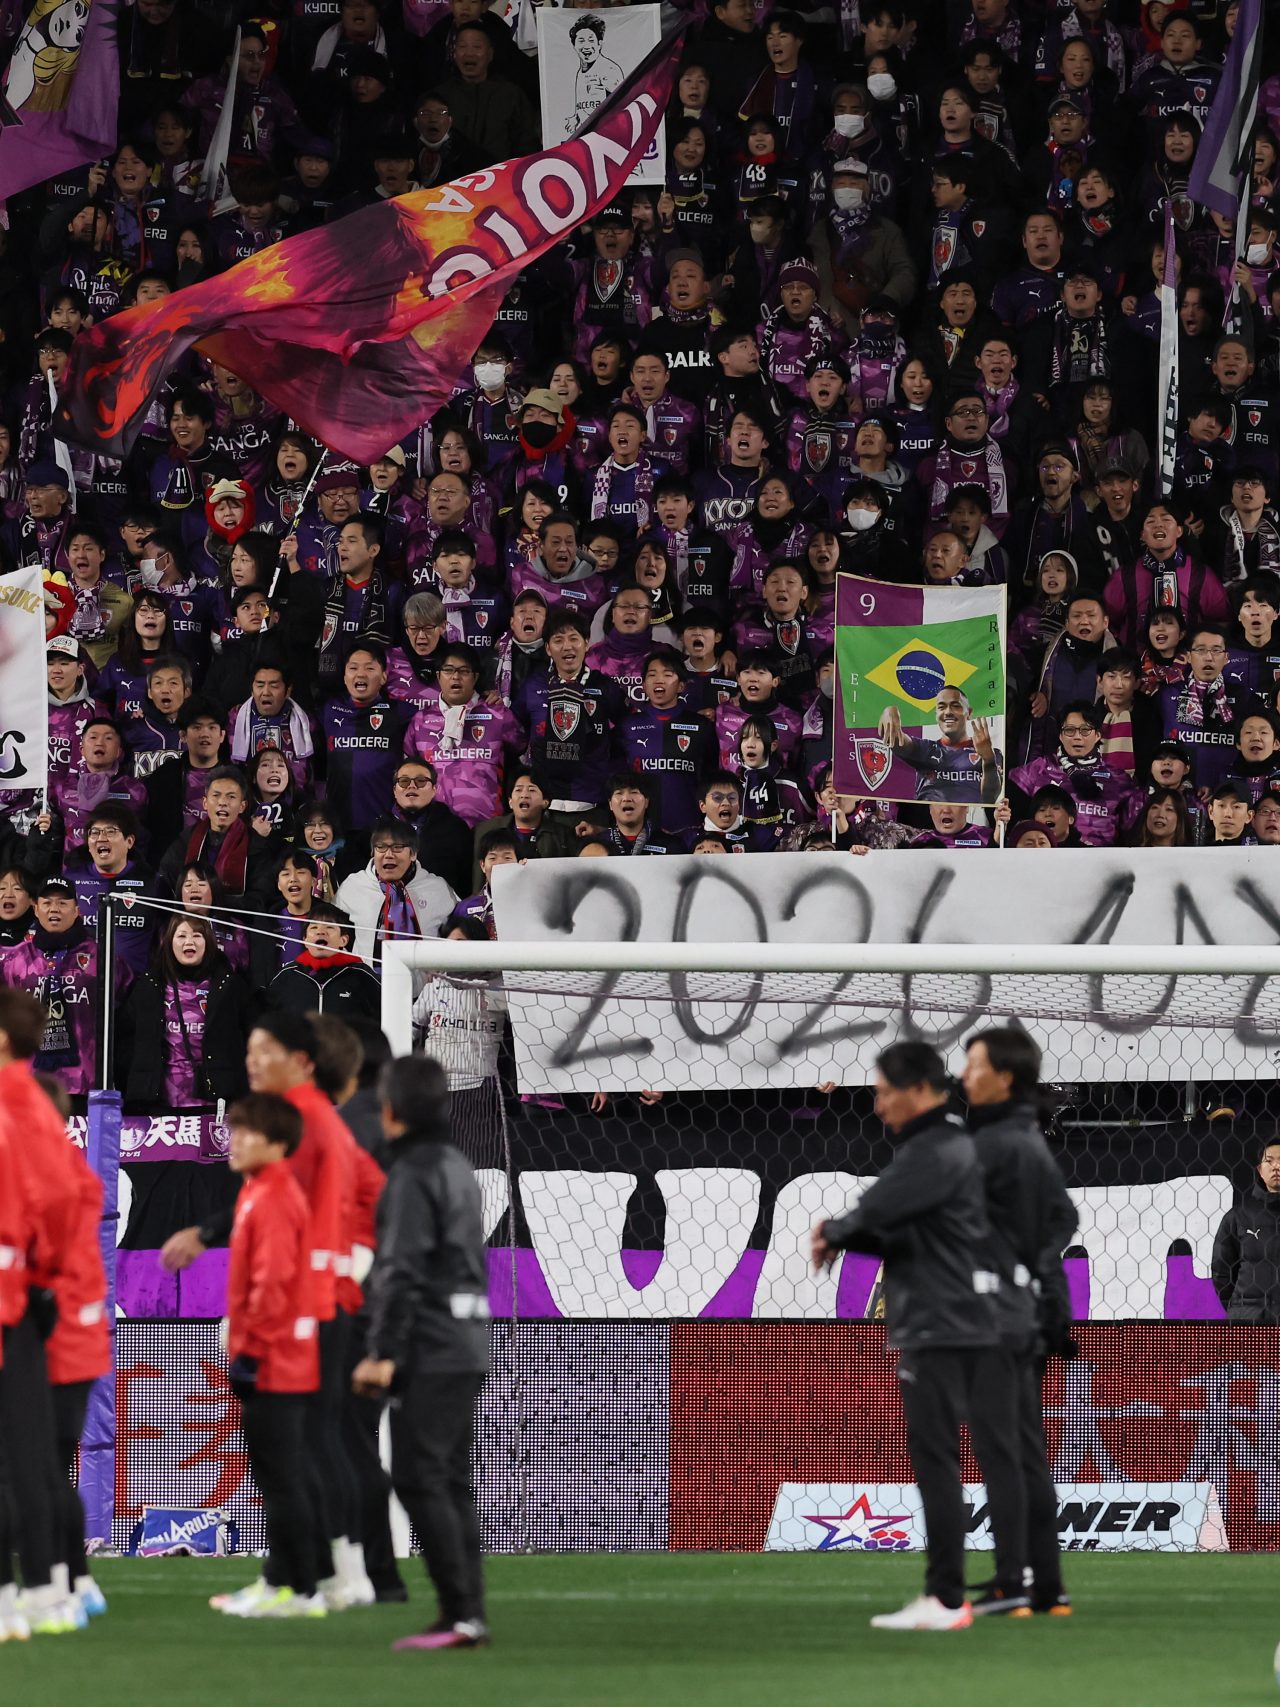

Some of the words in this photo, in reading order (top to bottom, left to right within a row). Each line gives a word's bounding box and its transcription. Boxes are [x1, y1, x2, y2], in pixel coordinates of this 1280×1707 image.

[746, 164, 766, 181] 48
[483, 433, 509, 441] SANGA
[558, 485, 567, 503] 9
[0, 585, 43, 614] SUKE
[860, 593, 875, 615] 9
[334, 736, 389, 748] KYOCERA
[1178, 730, 1234, 746] KYOCERA
[642, 758, 694, 773] KYOCERA
[750, 785, 768, 803] 44
[262, 806, 282, 822] 22
[1077, 804, 1108, 816] CERA
[83, 914, 144, 927] KYCERA
